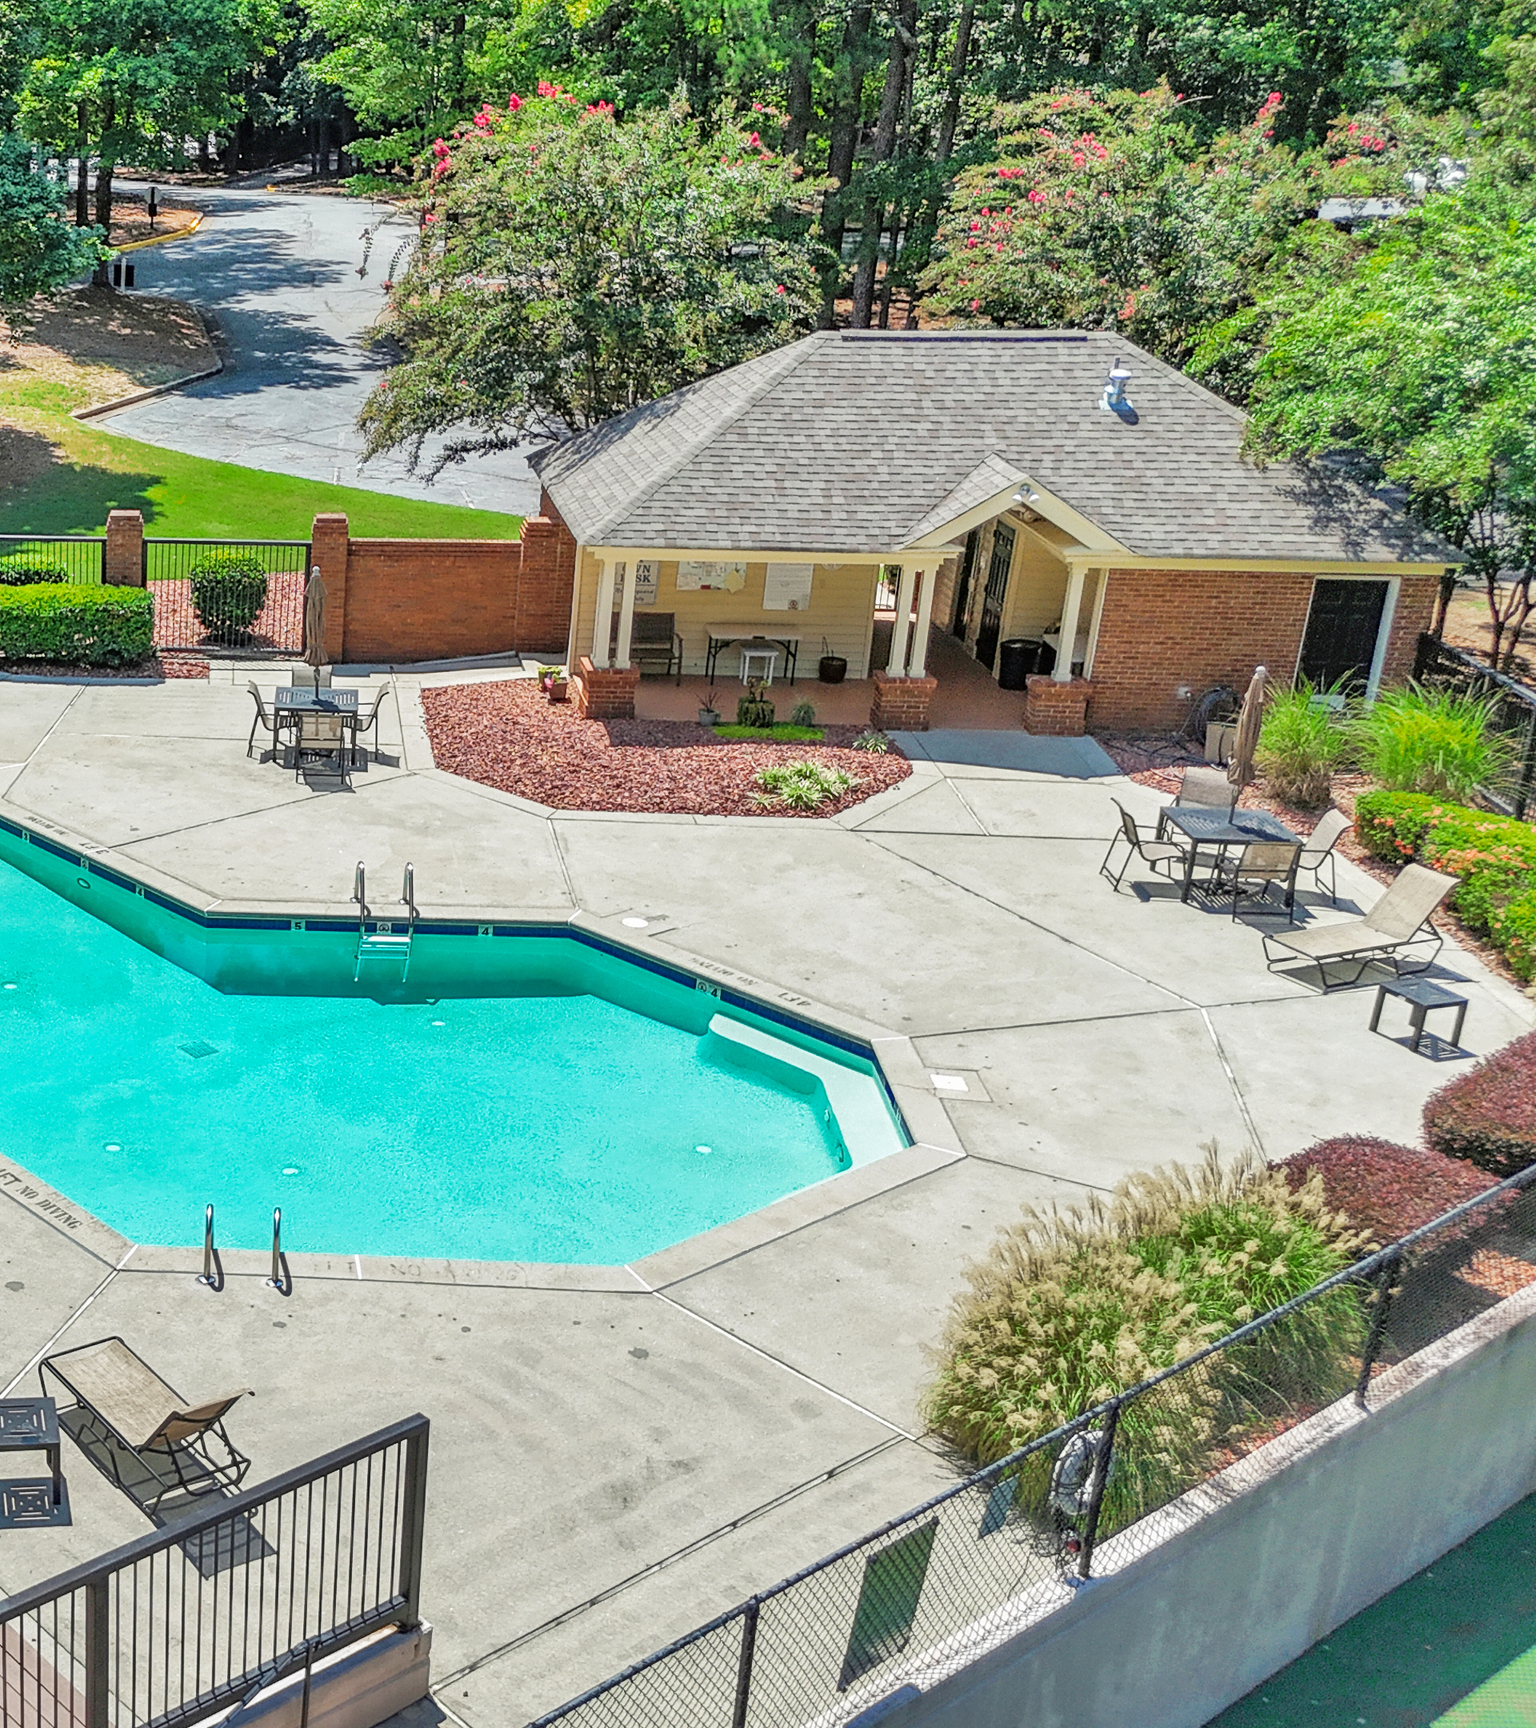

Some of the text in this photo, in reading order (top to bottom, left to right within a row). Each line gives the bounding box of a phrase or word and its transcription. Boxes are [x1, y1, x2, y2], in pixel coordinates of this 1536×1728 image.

[294, 921, 302, 930] 5
[481, 926, 490, 936] 4
[711, 988, 718, 998] 4
[15, 1185, 39, 1200] NO
[35, 1199, 83, 1229] DIVING
